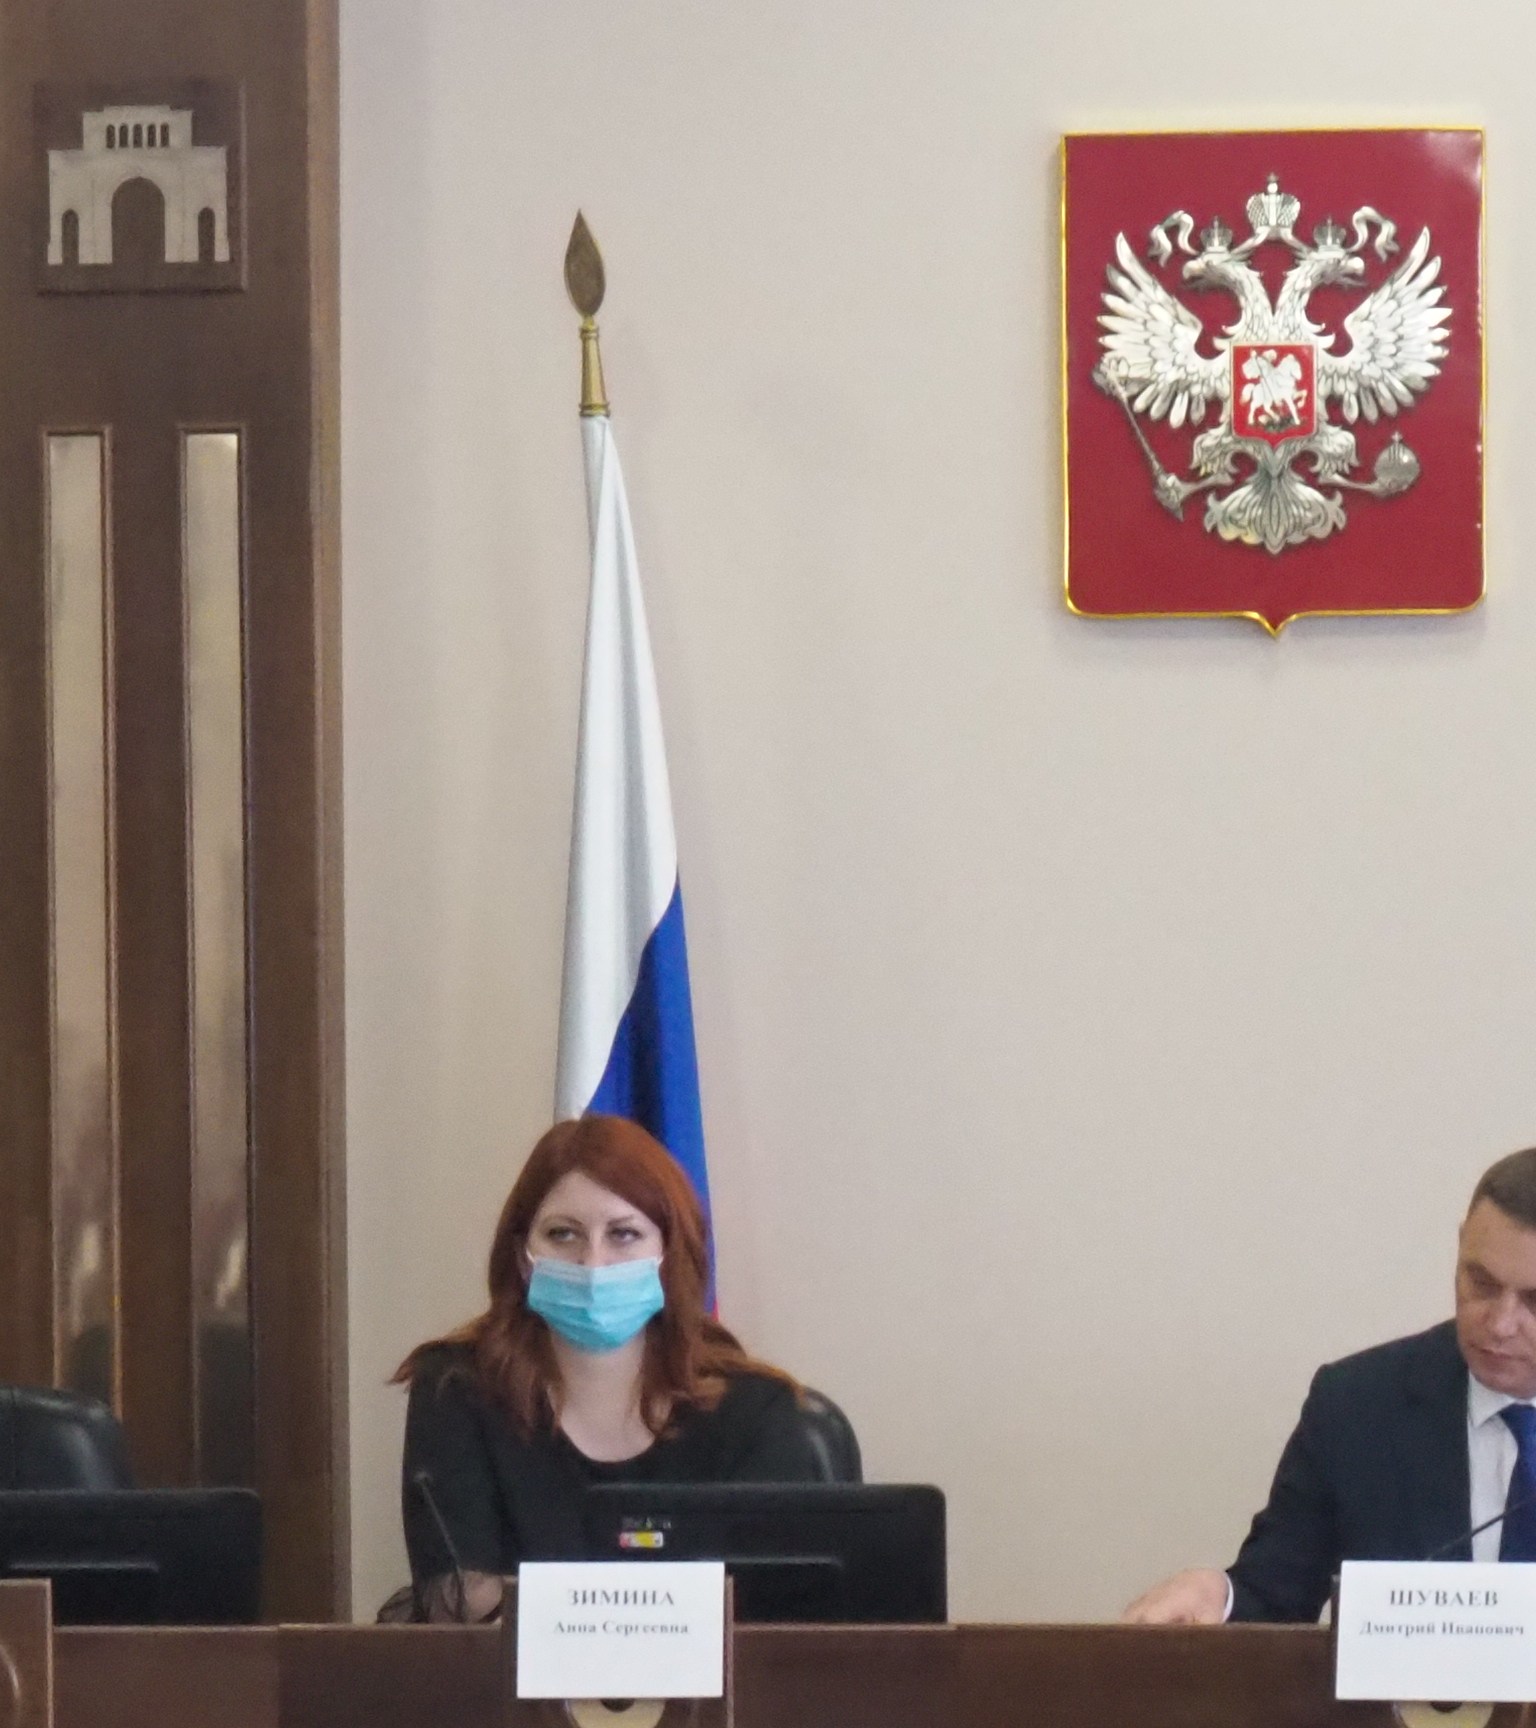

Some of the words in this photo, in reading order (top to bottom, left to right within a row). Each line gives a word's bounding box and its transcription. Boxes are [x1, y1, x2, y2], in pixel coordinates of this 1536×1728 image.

[569, 1589, 675, 1606] ЗИМИНА
[1389, 1589, 1500, 1607] ШУВАЕВ
[553, 1620, 597, 1635] Анна
[602, 1620, 689, 1637] Сергеевна
[1359, 1620, 1436, 1638] Дмитрий
[1441, 1620, 1525, 1636] Иванович
